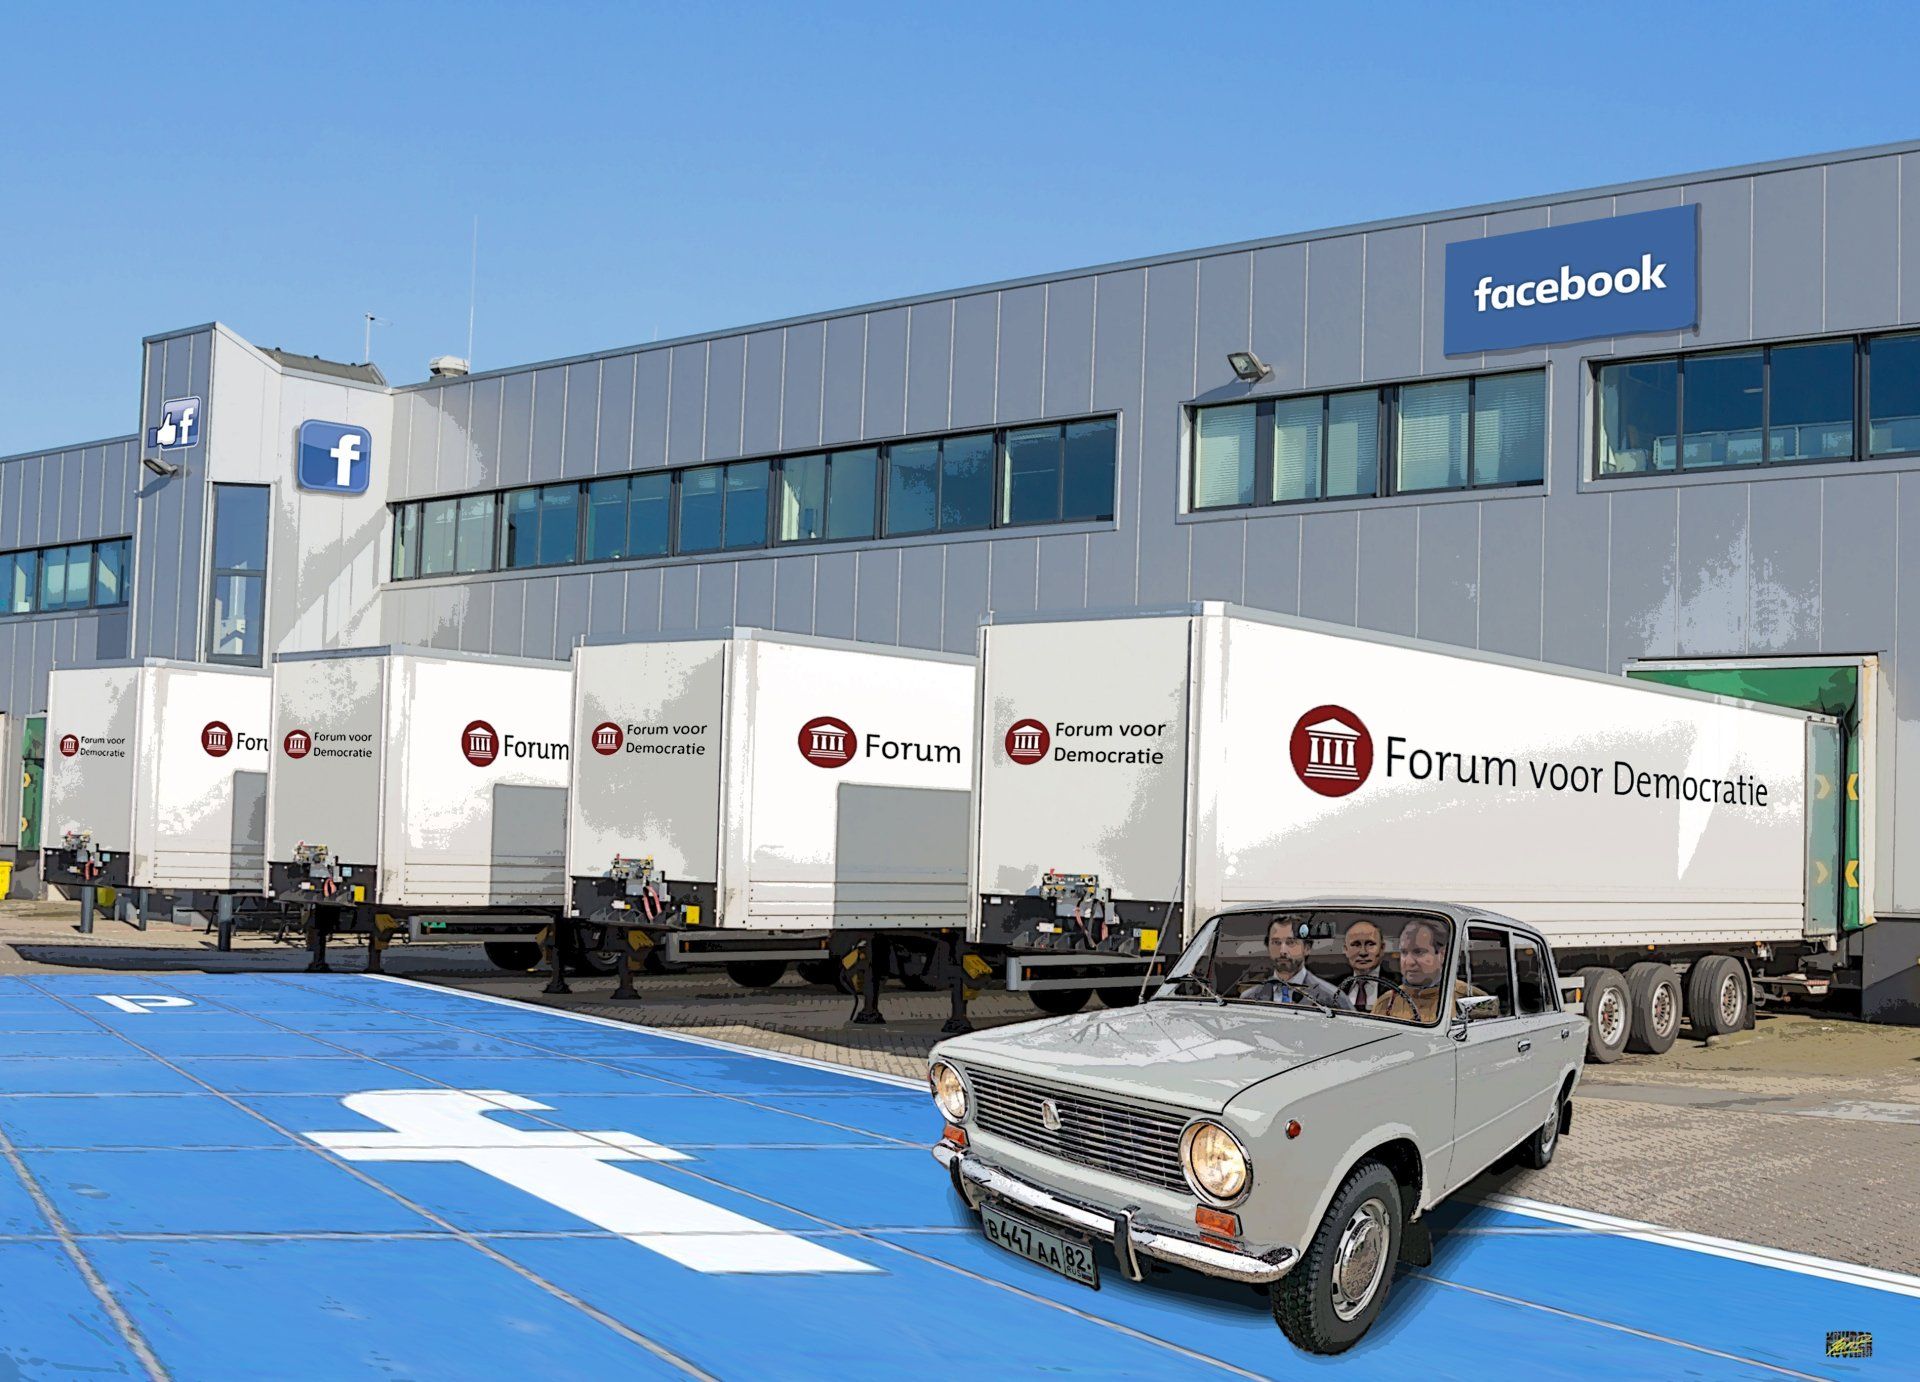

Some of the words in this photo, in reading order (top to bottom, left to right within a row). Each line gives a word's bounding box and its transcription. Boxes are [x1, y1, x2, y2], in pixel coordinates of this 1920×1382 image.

[1475, 253, 1667, 312] facebook
[179, 407, 194, 444] f
[330, 434, 361, 486] f
[313, 731, 348, 742] Forum
[349, 732, 373, 742] voor
[626, 725, 671, 736] Forum
[672, 725, 708, 736] voor
[1055, 722, 1116, 737] Forum
[1118, 722, 1167, 737] voor
[80, 735, 106, 745] Forum
[107, 736, 126, 745] voor
[504, 734, 569, 761] Forum
[80, 748, 126, 758] Democratie
[313, 746, 372, 758] Democratie
[626, 742, 707, 756] Democratie
[866, 733, 961, 764] Forum
[1054, 747, 1164, 765] Democratie
[1386, 735, 1517, 787] Forum
[1528, 760, 1605, 794] voor
[1613, 759, 1768, 807] Democratie
